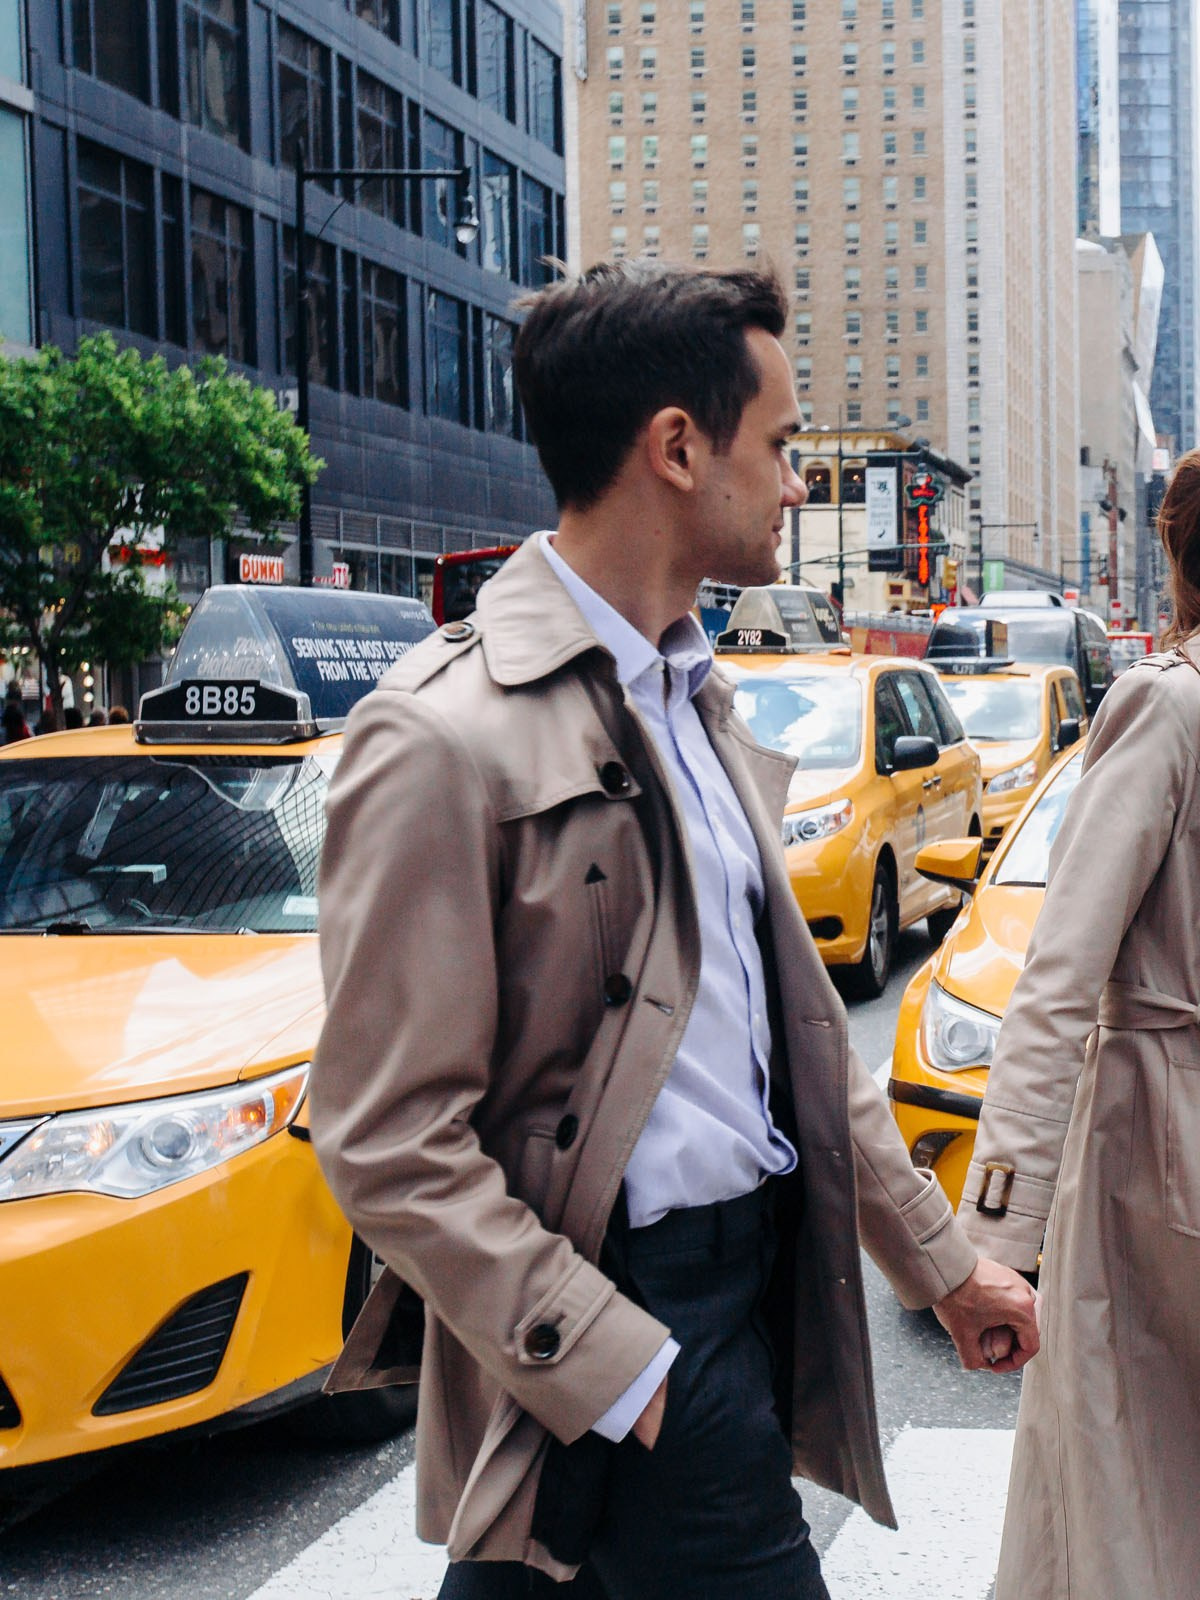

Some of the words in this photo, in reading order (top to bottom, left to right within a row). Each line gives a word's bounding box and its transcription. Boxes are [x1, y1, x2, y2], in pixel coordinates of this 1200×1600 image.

[292, 637, 339, 659] SERVING
[336, 639, 361, 660] THE
[357, 640, 389, 660] MOST
[737, 630, 763, 646] 2Y82
[316, 660, 350, 681] FROM
[346, 661, 370, 681] THE
[185, 685, 257, 716] 8B85
